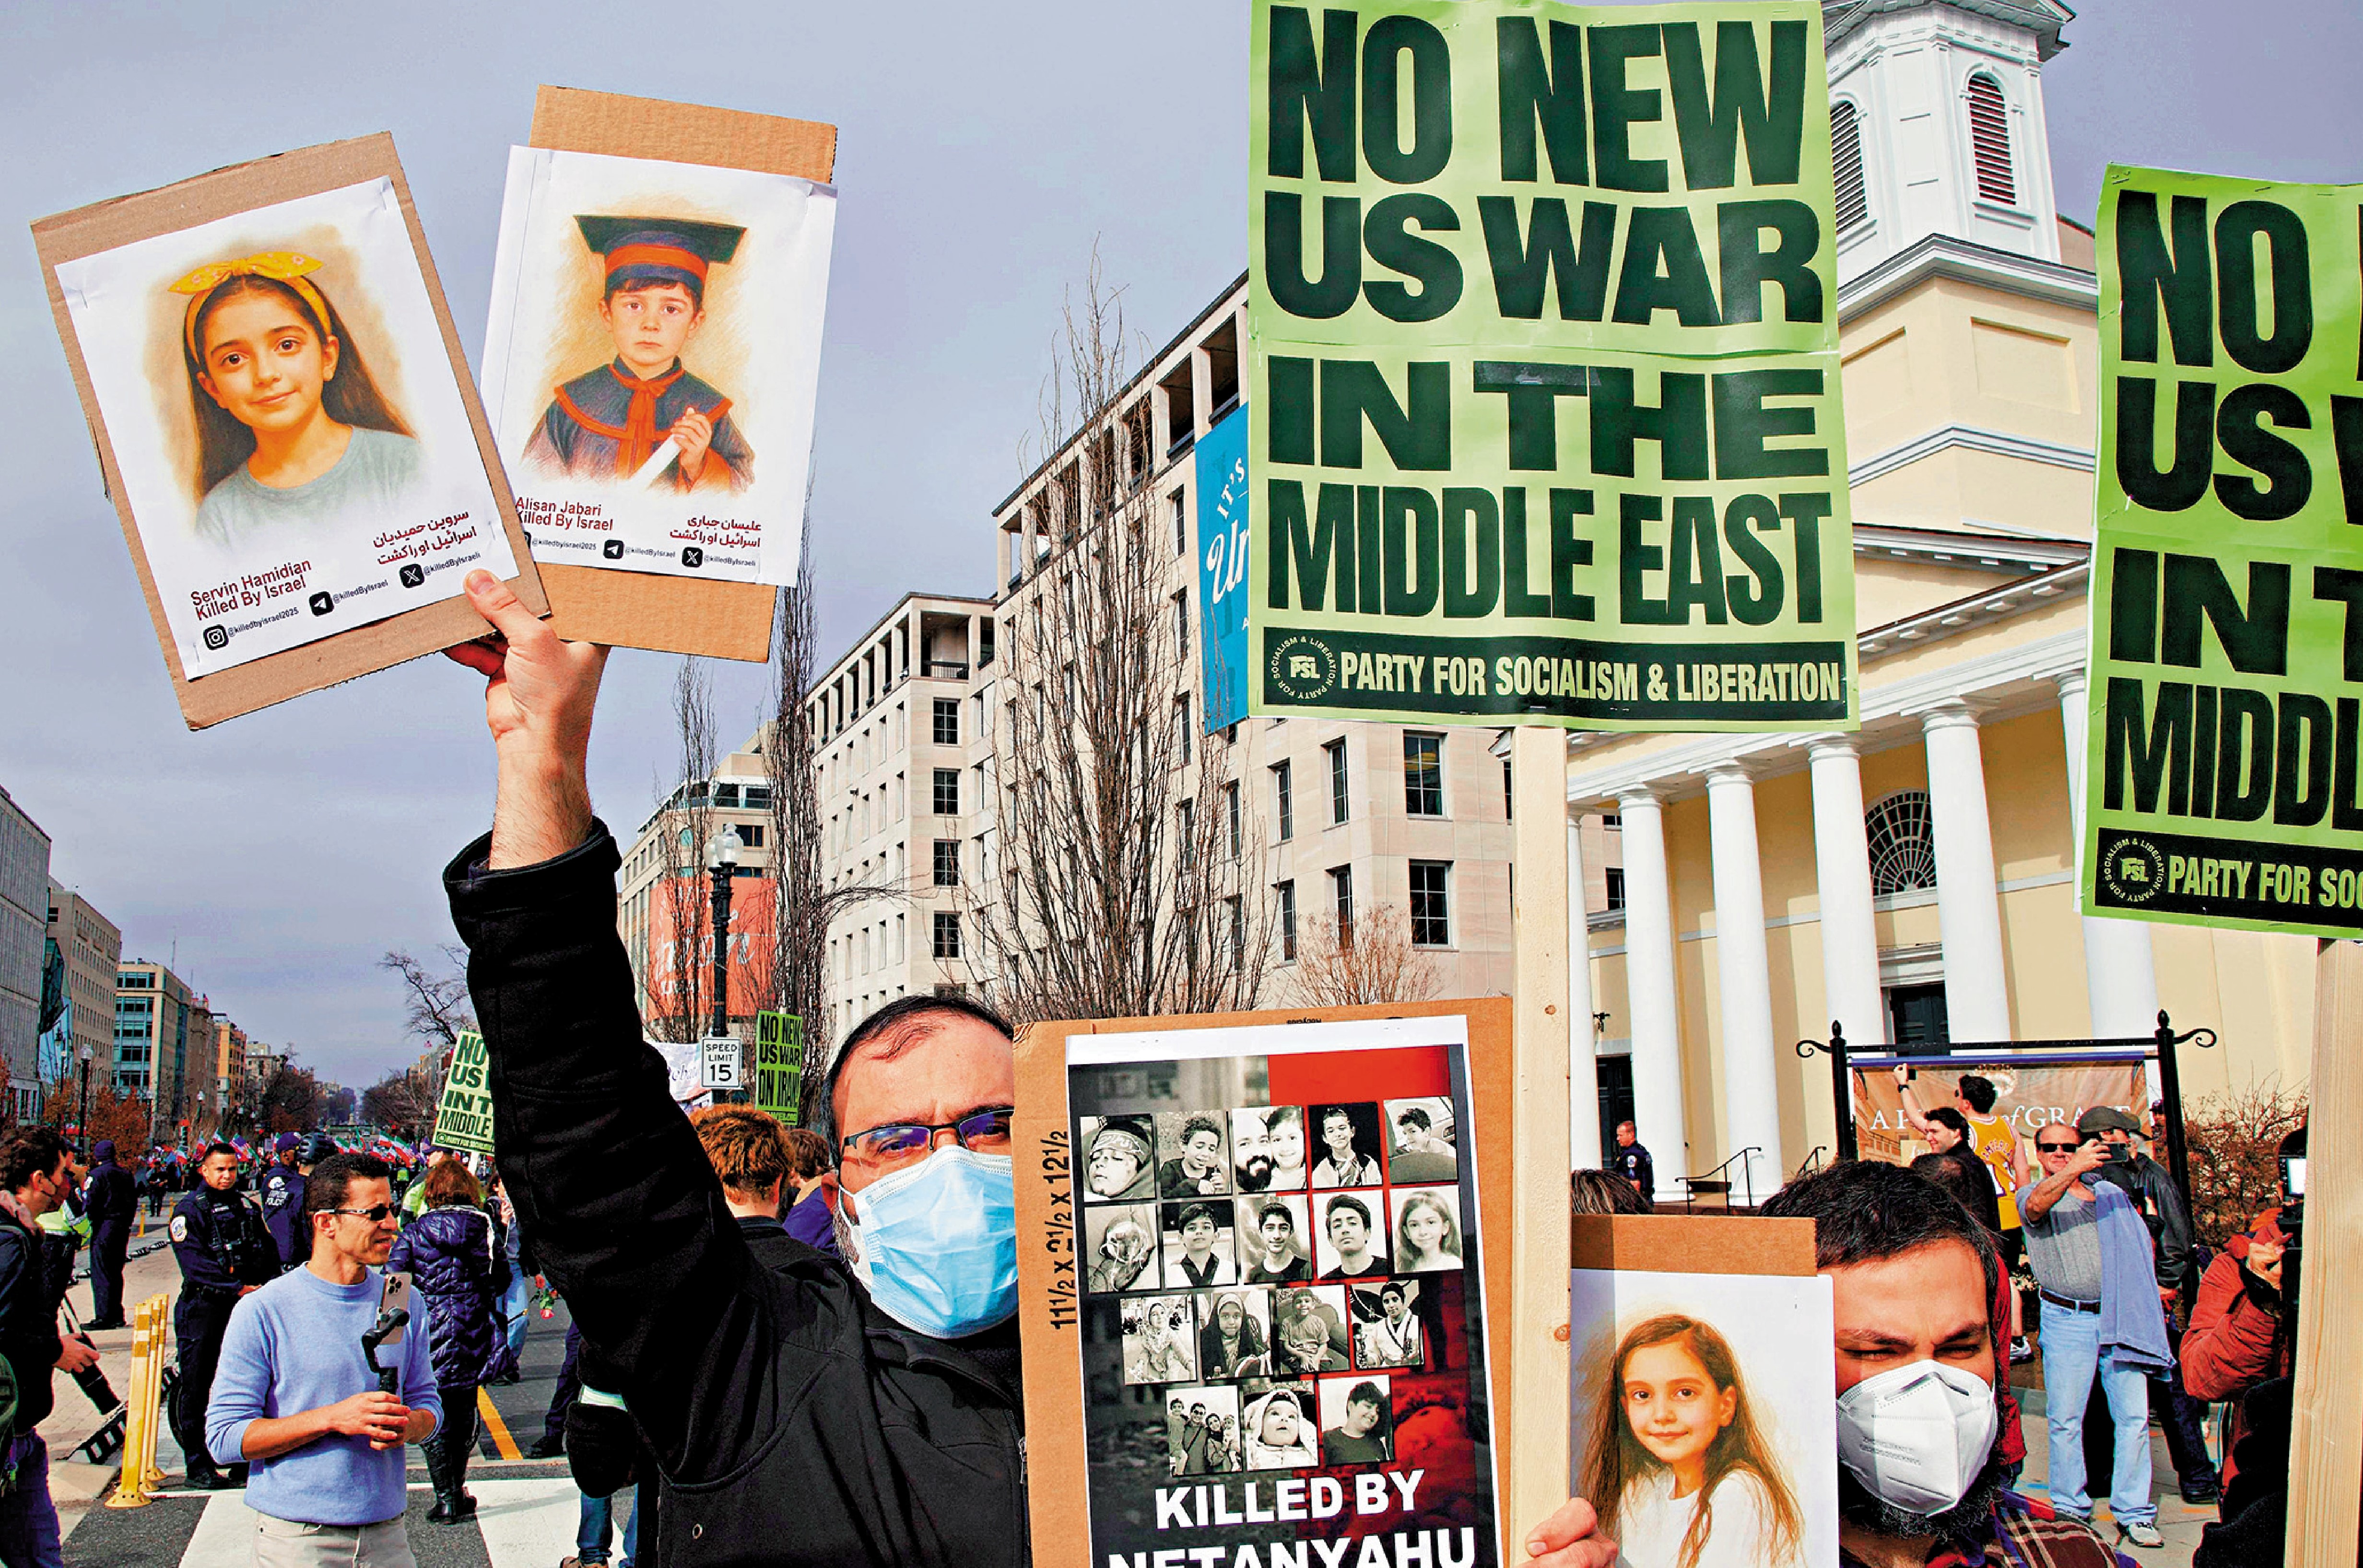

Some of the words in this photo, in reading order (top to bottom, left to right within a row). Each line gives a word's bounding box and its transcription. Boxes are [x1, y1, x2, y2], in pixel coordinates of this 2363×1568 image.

[1268, 5, 1453, 184] NO
[1496, 16, 1808, 192] NEW
[1264, 191, 1464, 322] US
[1477, 196, 1823, 327] WAR
[2116, 189, 2313, 374] NO
[1268, 355, 1451, 472] IN
[1473, 361, 1830, 480] THE
[2116, 376, 2313, 521] US
[516, 497, 557, 512] Alisan
[560, 501, 601, 516] Jabari
[555, 514, 573, 530] By
[576, 515, 613, 531] Israel
[1268, 478, 1596, 623] MIDDLE
[1620, 491, 1832, 626] EAST
[190, 582, 239, 606] Servin
[241, 560, 312, 590] Hamidian
[195, 596, 238, 620] Killed
[241, 591, 261, 607] By
[264, 573, 306, 598] Israel
[2109, 547, 2291, 676] IN
[1341, 651, 1425, 693] PARTY
[1433, 656, 1487, 696] FOR
[1495, 655, 1638, 702] SOCIALISM
[1646, 662, 1669, 702] &
[1676, 661, 1840, 702] LIBERATION
[2167, 855, 2253, 901] PARTY
[2258, 861, 2311, 905] FOR
[456, 1035, 487, 1065] NO
[705, 1043, 738, 1052] SPEED
[761, 1015, 779, 1043] NO
[451, 1064, 484, 1088] US
[710, 1064, 732, 1082] 15
[759, 1043, 777, 1064] US
[445, 1090, 475, 1111] IN
[758, 1069, 774, 1107] ON
[438, 1110, 492, 1138] MIDDLE
[1155, 1477, 1344, 1530] KILLED
[1355, 1468, 1425, 1515] BY
